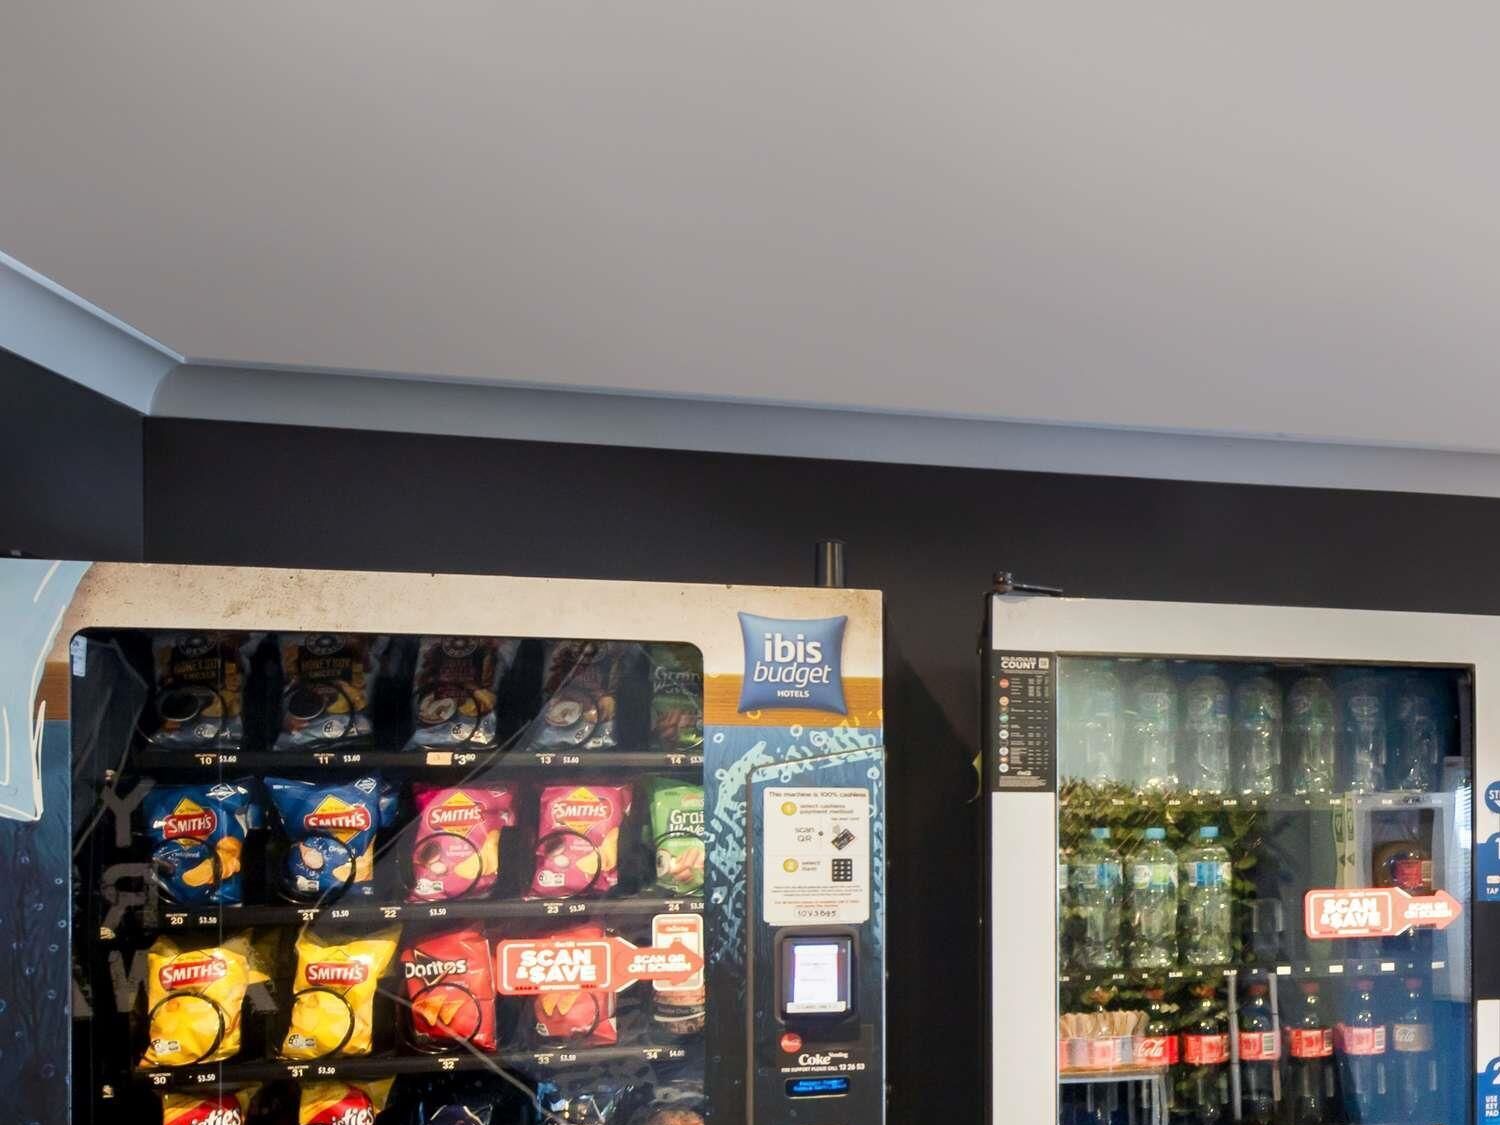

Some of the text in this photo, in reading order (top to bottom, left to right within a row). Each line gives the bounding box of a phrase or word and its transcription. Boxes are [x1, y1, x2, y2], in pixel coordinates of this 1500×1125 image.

[764, 633, 822, 663] ibis
[1001, 660, 1037, 670] COUNT
[753, 661, 832, 688] budget
[777, 690, 810, 698] HOTELS
[200, 757, 213, 766] 10
[318, 756, 329, 765] 11
[540, 756, 552, 765] 13
[671, 756, 682, 765] 14
[558, 802, 609, 817] SMITH'S
[308, 811, 366, 828] SMITH'S
[430, 807, 482, 824] SMITH'S
[168, 815, 213, 834] SMITH'S
[1486, 887, 1499, 895] TAP
[547, 905, 559, 914] 23
[668, 904, 680, 912] 24
[1323, 898, 1378, 913] SCAN
[302, 912, 314, 921] 21
[384, 910, 397, 918] 22
[170, 917, 183, 925] 20
[520, 949, 592, 967] SCAN
[633, 954, 664, 964] SCAN
[162, 960, 226, 985] SMITH'S
[308, 964, 365, 982] SMITH'S
[405, 959, 467, 979] Doritos
[799, 1053, 831, 1066] Coke
[442, 1060, 455, 1070] 32
[292, 1068, 303, 1077] 31
[153, 1076, 167, 1085] 30
